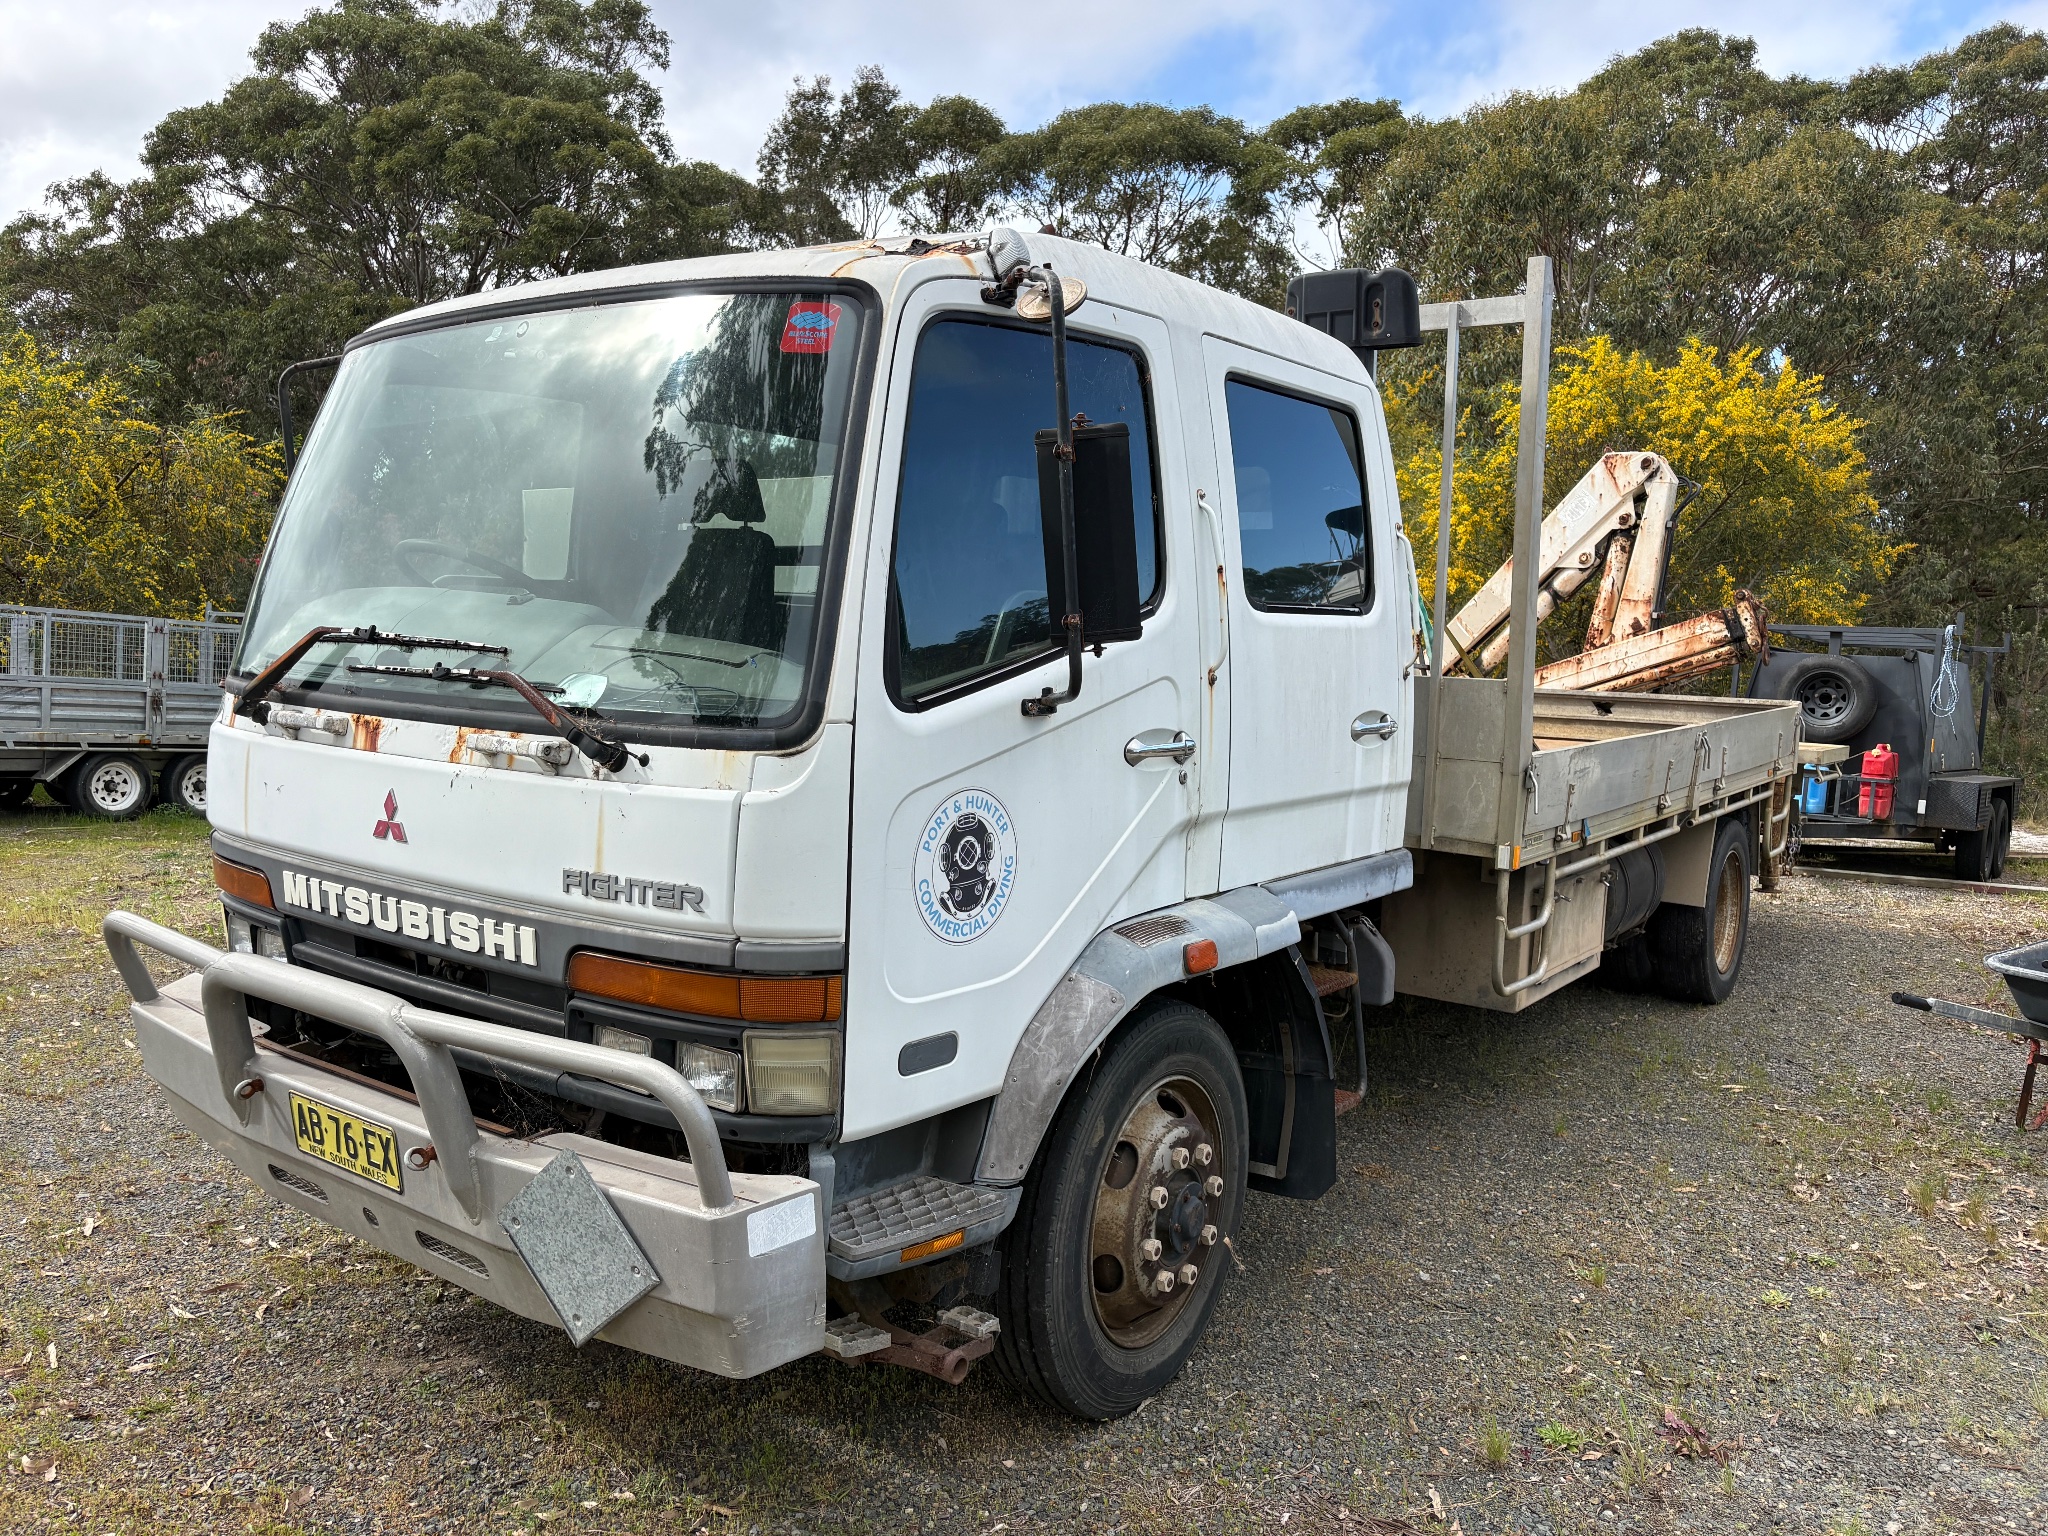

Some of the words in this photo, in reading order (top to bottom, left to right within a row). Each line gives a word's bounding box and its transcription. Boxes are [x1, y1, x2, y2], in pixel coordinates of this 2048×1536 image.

[922, 806, 950, 853] PORT
[953, 800, 963, 814] &
[965, 795, 1009, 836] HUNTER
[282, 870, 538, 967] MITSUBISHI
[562, 867, 705, 913] FIGHTER
[918, 878, 989, 938] COMMERCIAL
[987, 855, 1014, 919] DIVING
[308, 1143, 326, 1159] NEW
[329, 1151, 357, 1171] SOUTH
[359, 1163, 388, 1185] WALES
